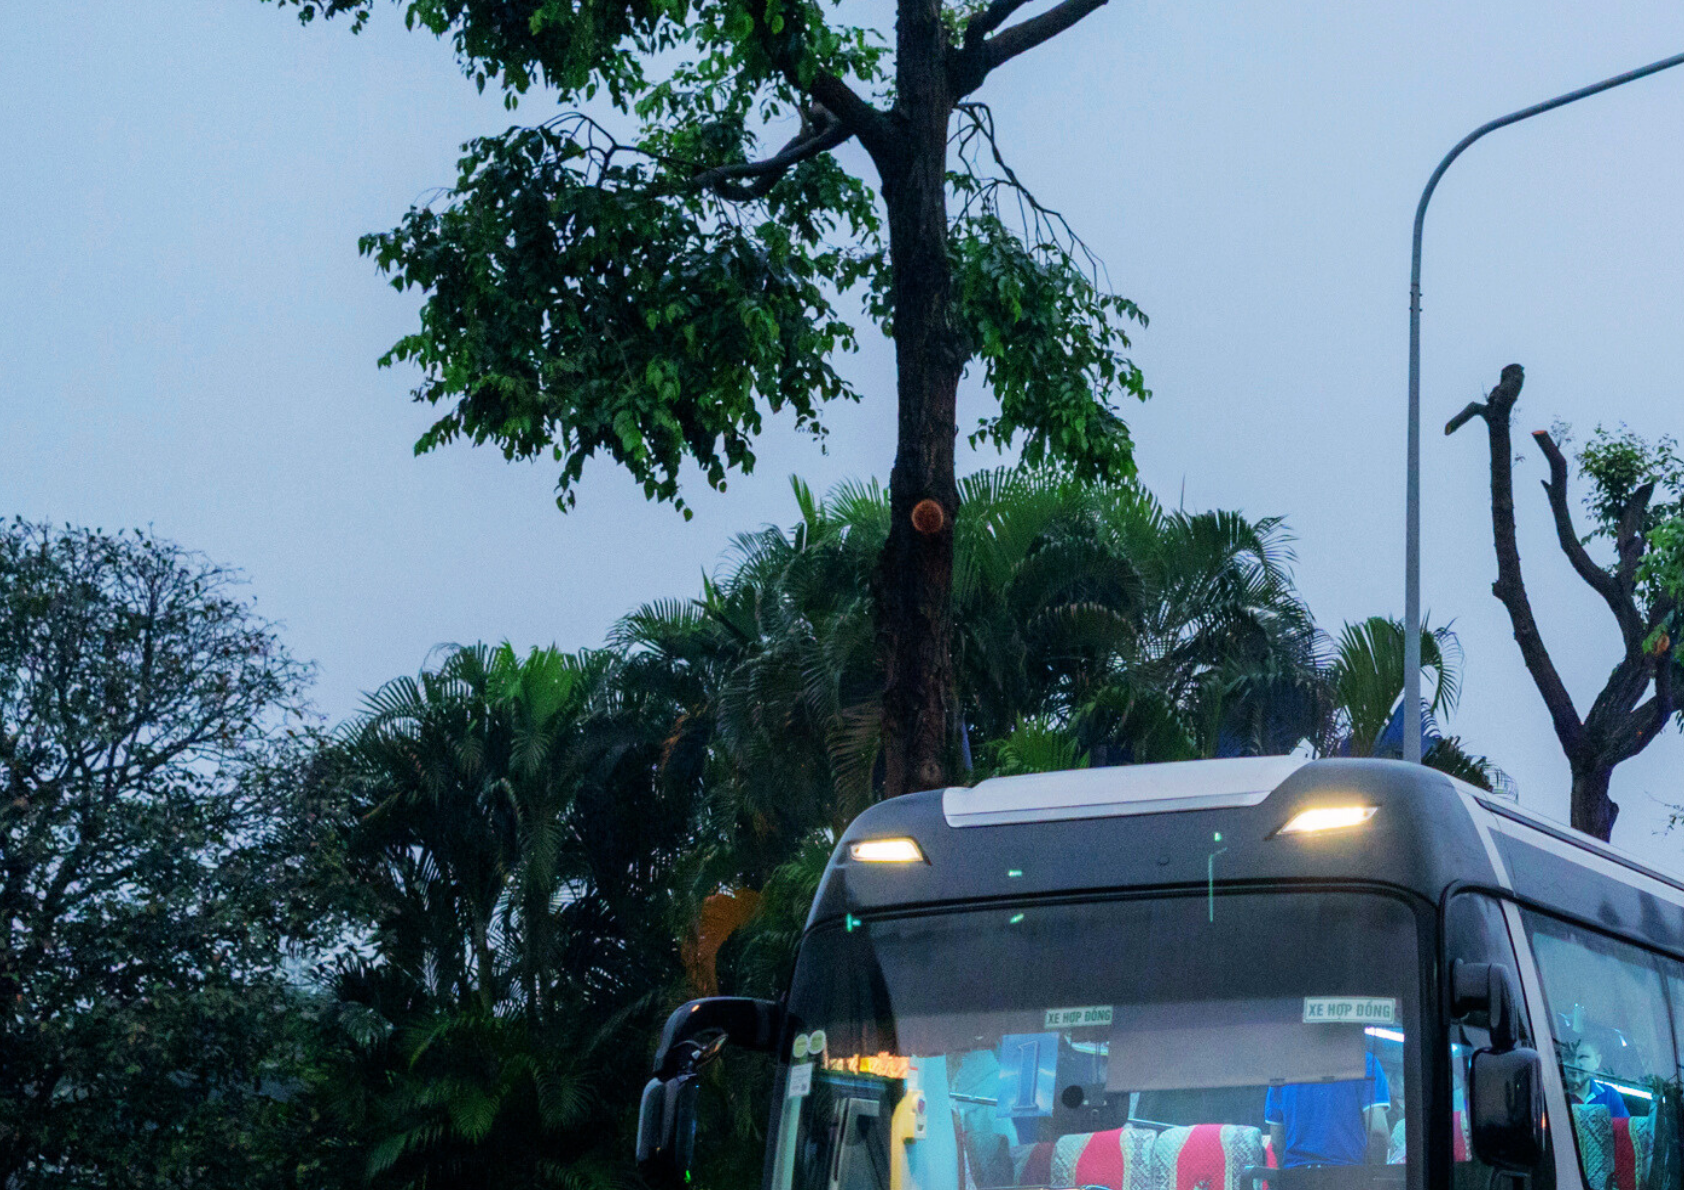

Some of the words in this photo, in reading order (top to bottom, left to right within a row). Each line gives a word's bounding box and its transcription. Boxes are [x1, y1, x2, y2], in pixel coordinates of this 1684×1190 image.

[1308, 1004, 1324, 1017] XE
[1048, 1012, 1060, 1024] XE
[1011, 1040, 1040, 1112] 1
